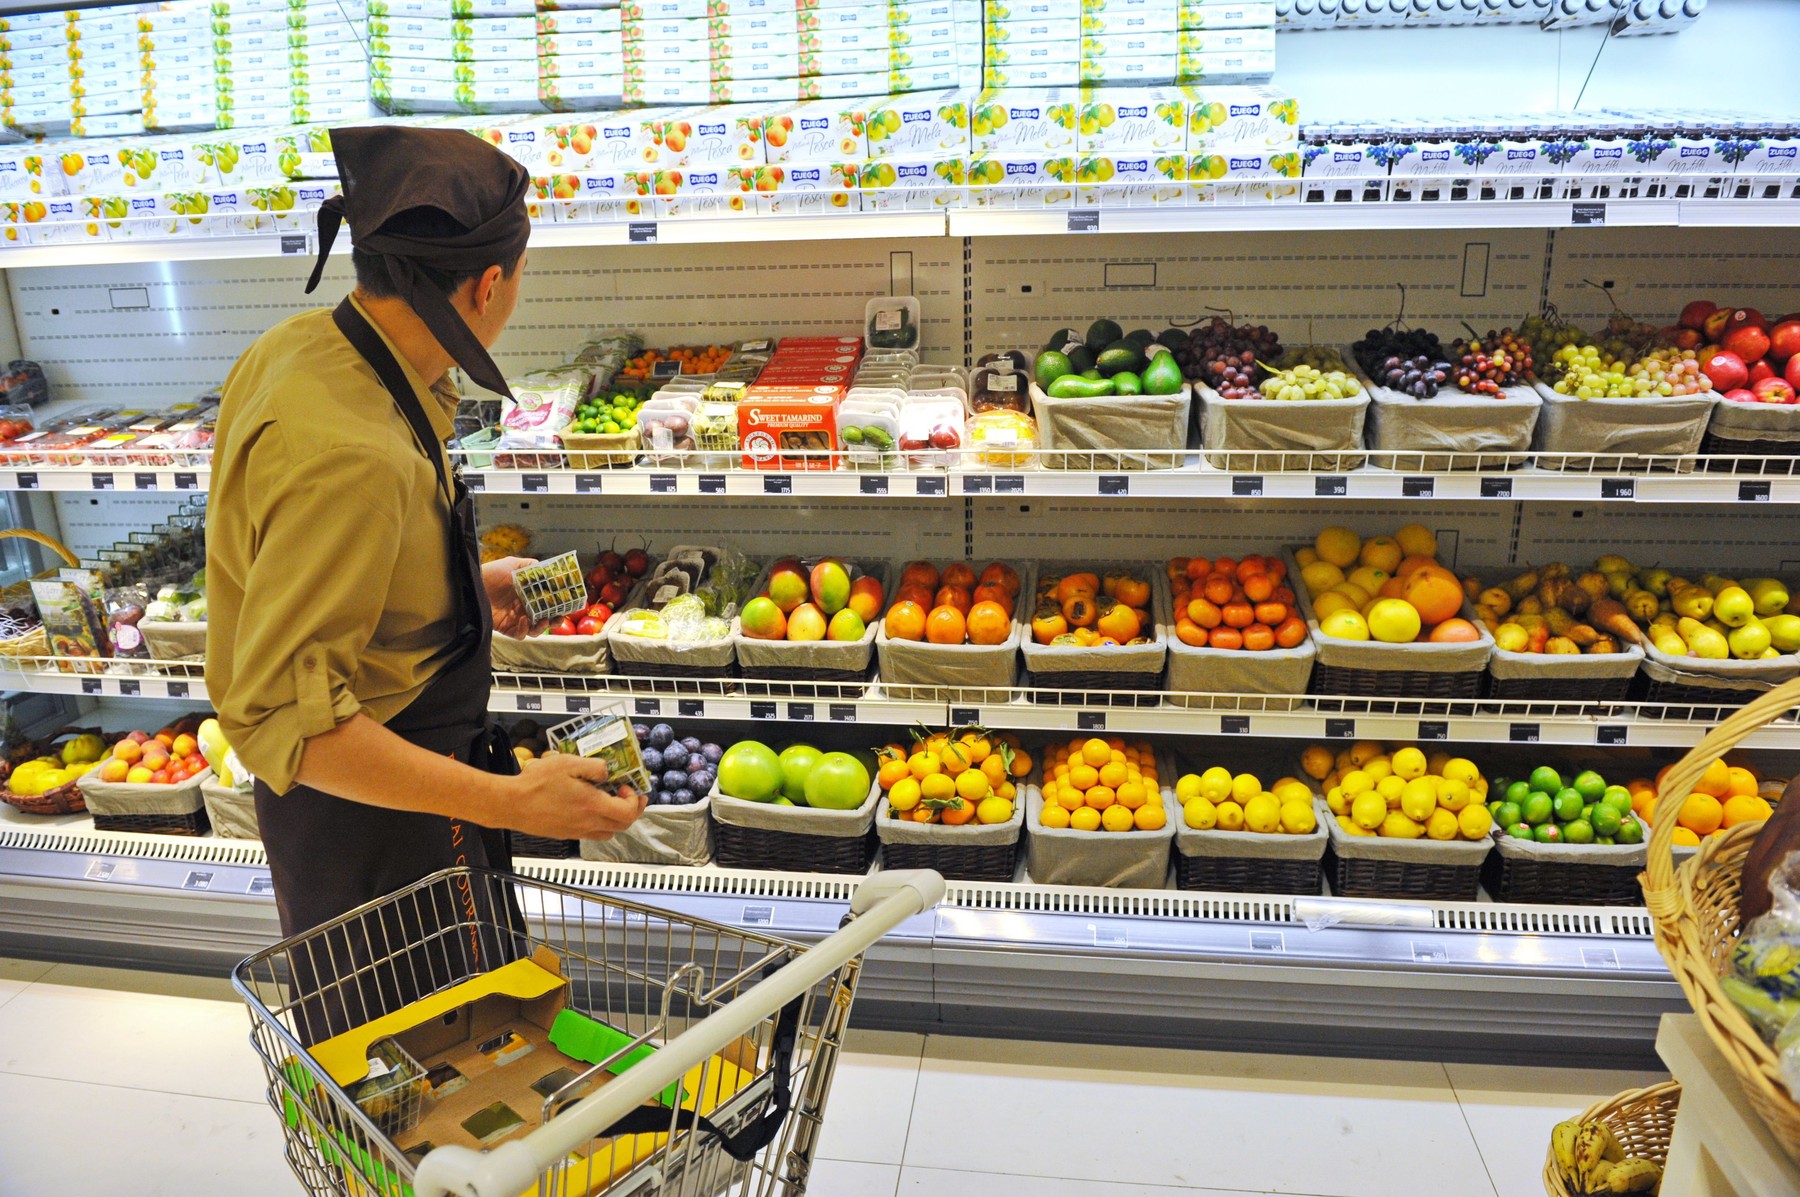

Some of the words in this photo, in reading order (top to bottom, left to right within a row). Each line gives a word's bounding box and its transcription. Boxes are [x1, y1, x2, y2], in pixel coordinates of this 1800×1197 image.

[1012, 110, 1038, 118] ZUEGG
[1119, 108, 1146, 116] ZUEGG
[1232, 106, 1259, 115] ZUEGG
[904, 112, 930, 121] ZUEGG
[802, 120, 827, 128] ZUEGG
[606, 129, 628, 137] ZUEGG
[1118, 162, 1146, 170] ZUEGG
[1232, 160, 1260, 168] ZUEGG
[900, 168, 926, 176] ZUEGG
[1008, 164, 1034, 173] ZUEGG
[793, 171, 818, 179] ZUEGG
[301, 190, 324, 198] ZUEGG
[781, 414, 822, 422] TAMARIND
